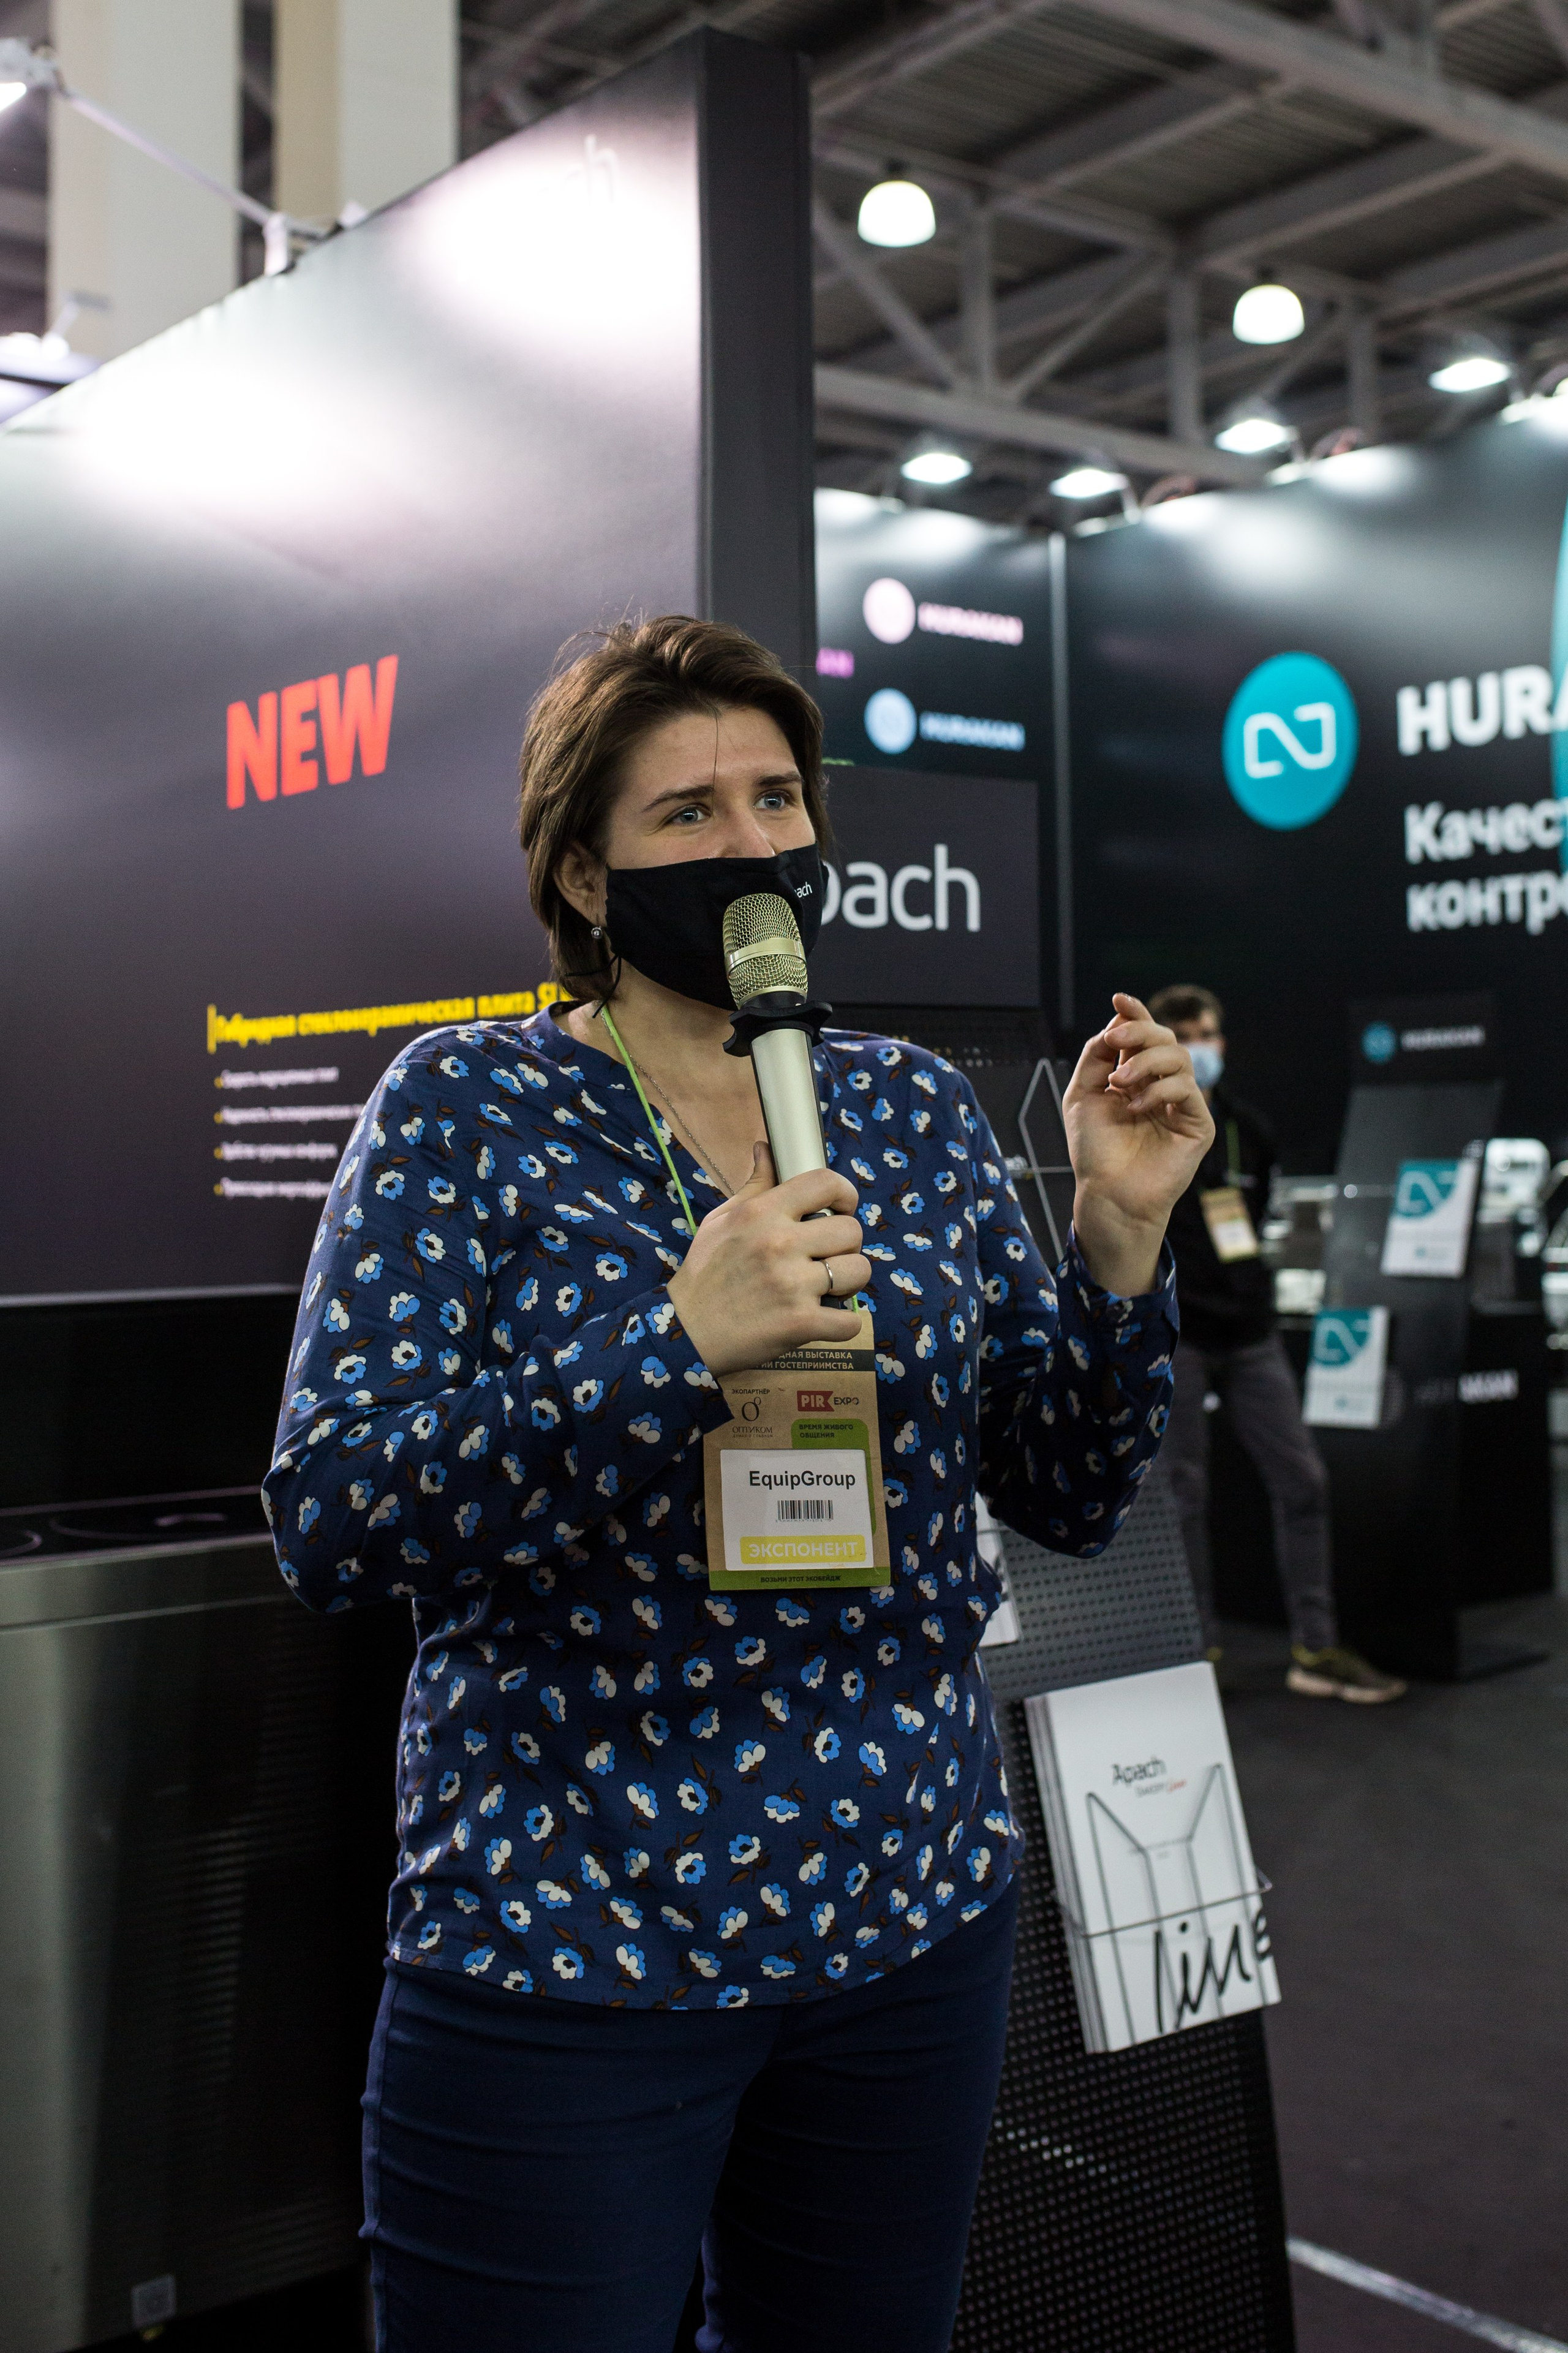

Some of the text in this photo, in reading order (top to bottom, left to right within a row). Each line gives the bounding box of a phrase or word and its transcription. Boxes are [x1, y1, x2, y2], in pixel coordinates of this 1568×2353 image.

[227, 654, 398, 809] NEW
[1404, 798, 1568, 864] Качес
[794, 882, 813, 898] ach
[775, 1361, 854, 1370] ГОСТЕПРИИМСТВА
[801, 1394, 859, 1408] PIR EXPO
[749, 1470, 856, 1490] EquipGroup
[748, 1541, 858, 1558] ЭКСПОНЕНТ
